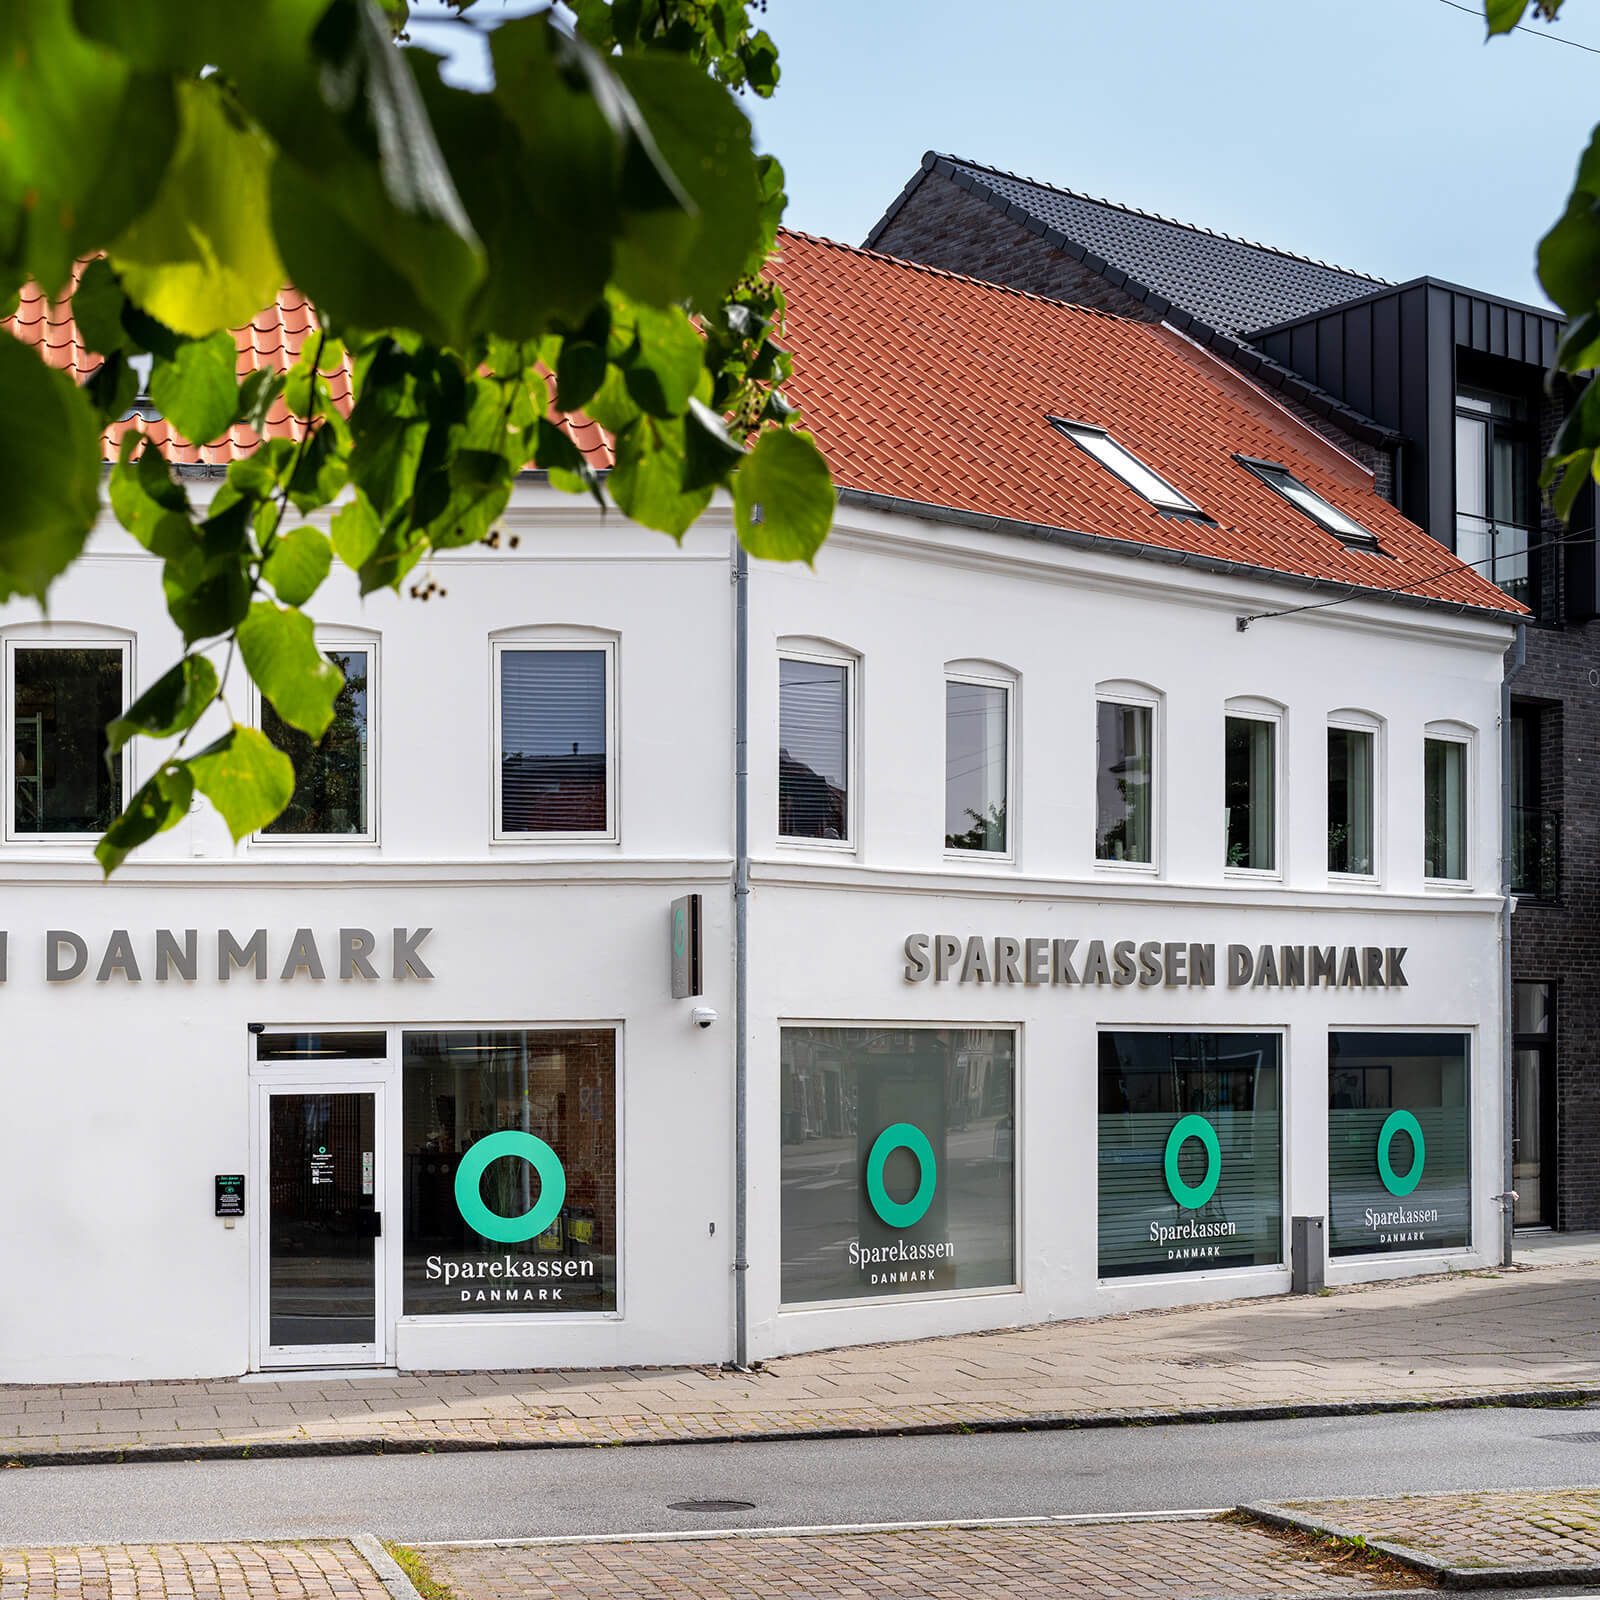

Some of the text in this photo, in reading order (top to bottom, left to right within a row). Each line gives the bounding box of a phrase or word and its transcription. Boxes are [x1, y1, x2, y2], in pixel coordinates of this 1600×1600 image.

[47, 928, 434, 981] DANMARK
[904, 935, 1408, 987] SPAREKASSEN DANMARK
[1364, 1206, 1438, 1231] Sparekassen
[1149, 1219, 1236, 1246] Sparekassen
[1380, 1231, 1425, 1243] DANMARK
[848, 1239, 954, 1268] Sparekassen
[1168, 1246, 1220, 1260] DANMARK
[425, 1255, 594, 1285] Sparekassen
[871, 1269, 935, 1285] DANMARK
[461, 1288, 562, 1302] DANMARK
